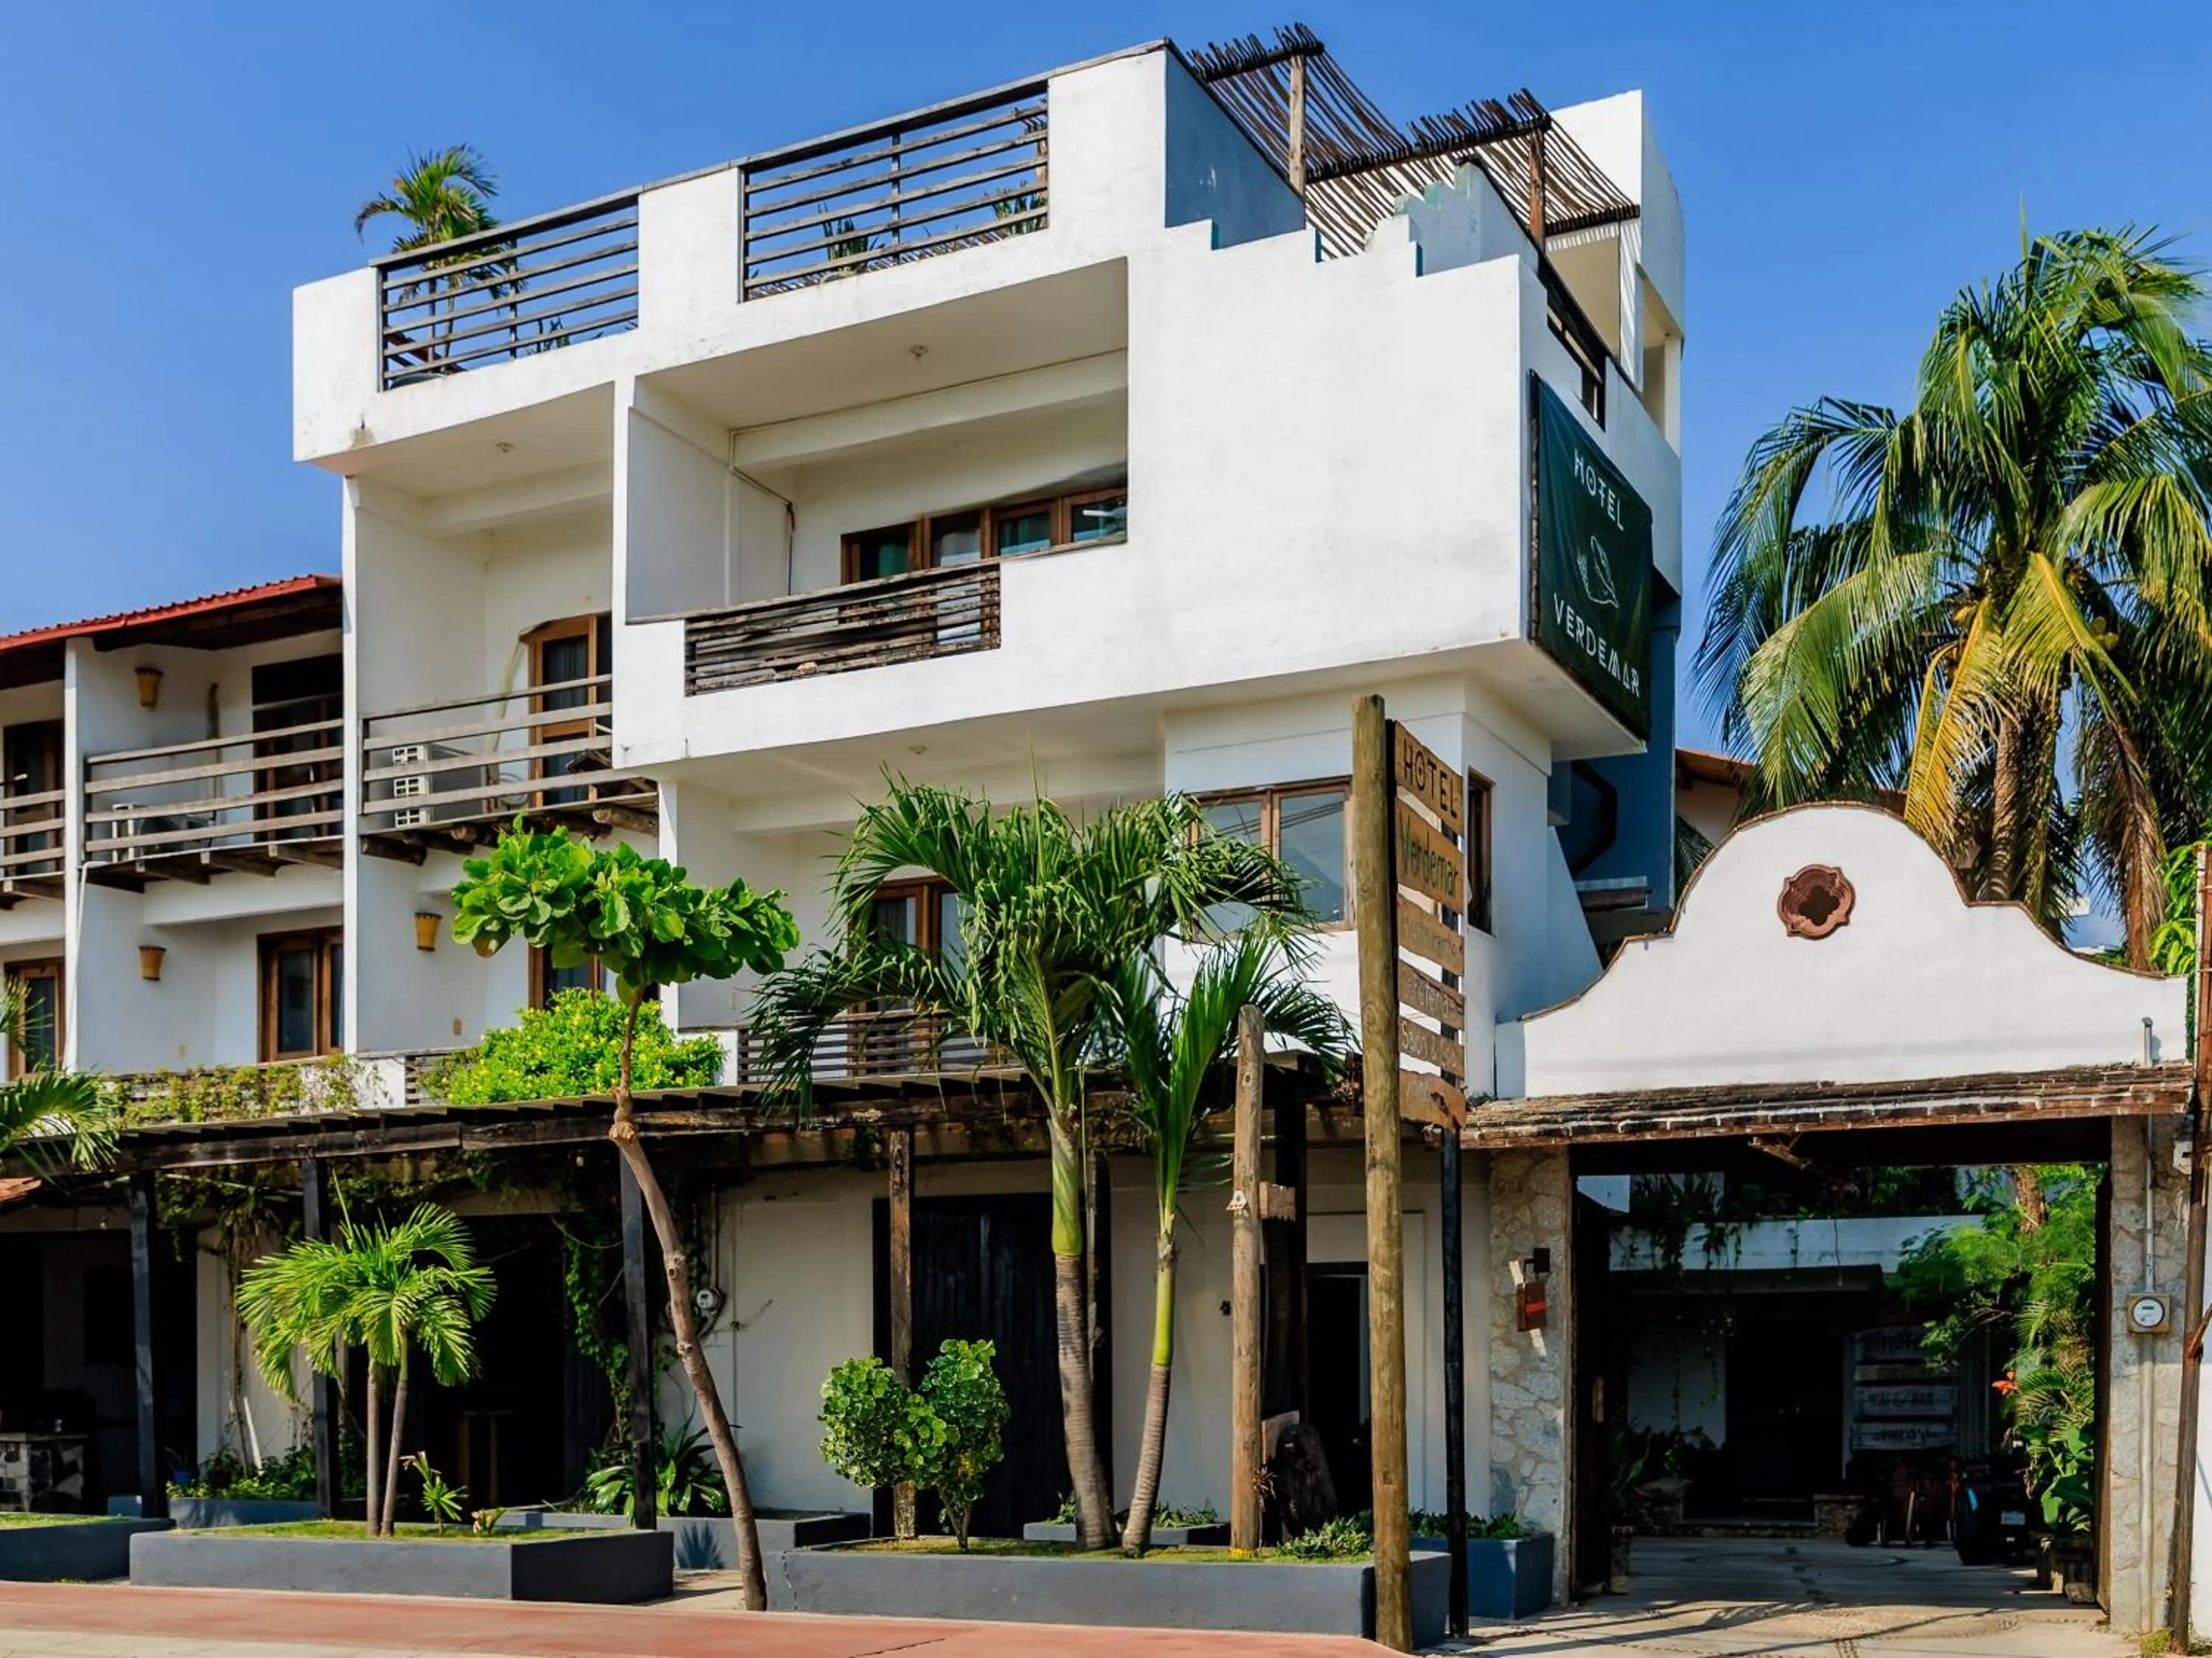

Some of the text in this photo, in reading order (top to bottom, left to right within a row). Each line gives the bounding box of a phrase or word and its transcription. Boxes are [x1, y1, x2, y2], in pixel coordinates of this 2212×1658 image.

[1573, 448, 1624, 532] HOTEL
[1554, 592, 1641, 699] VERDEMAR
[1403, 738, 1458, 819] HOTEL
[1399, 809, 1459, 898] Verdemar
